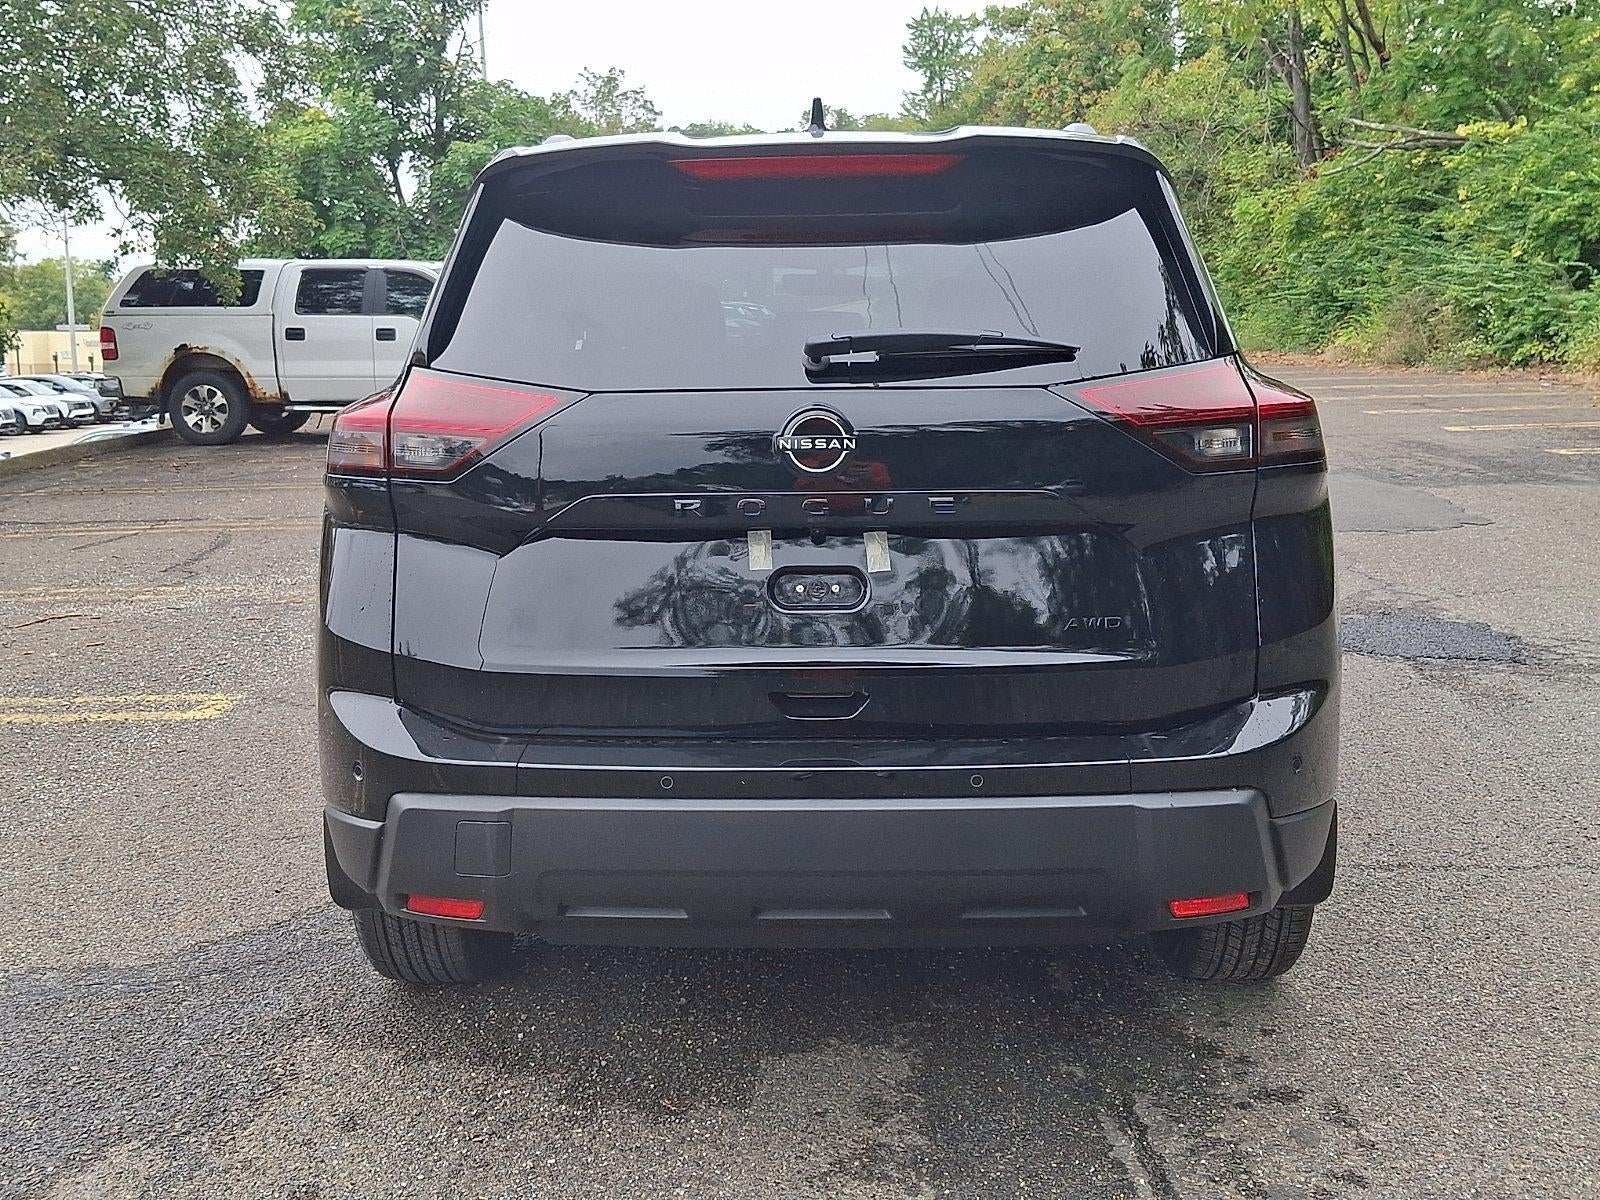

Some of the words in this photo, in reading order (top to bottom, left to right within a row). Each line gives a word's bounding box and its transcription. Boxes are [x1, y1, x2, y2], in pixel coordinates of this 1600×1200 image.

[779, 438, 857, 450] NISSAN
[673, 497, 957, 517] ROGUE
[1063, 616, 1122, 631] AWD
